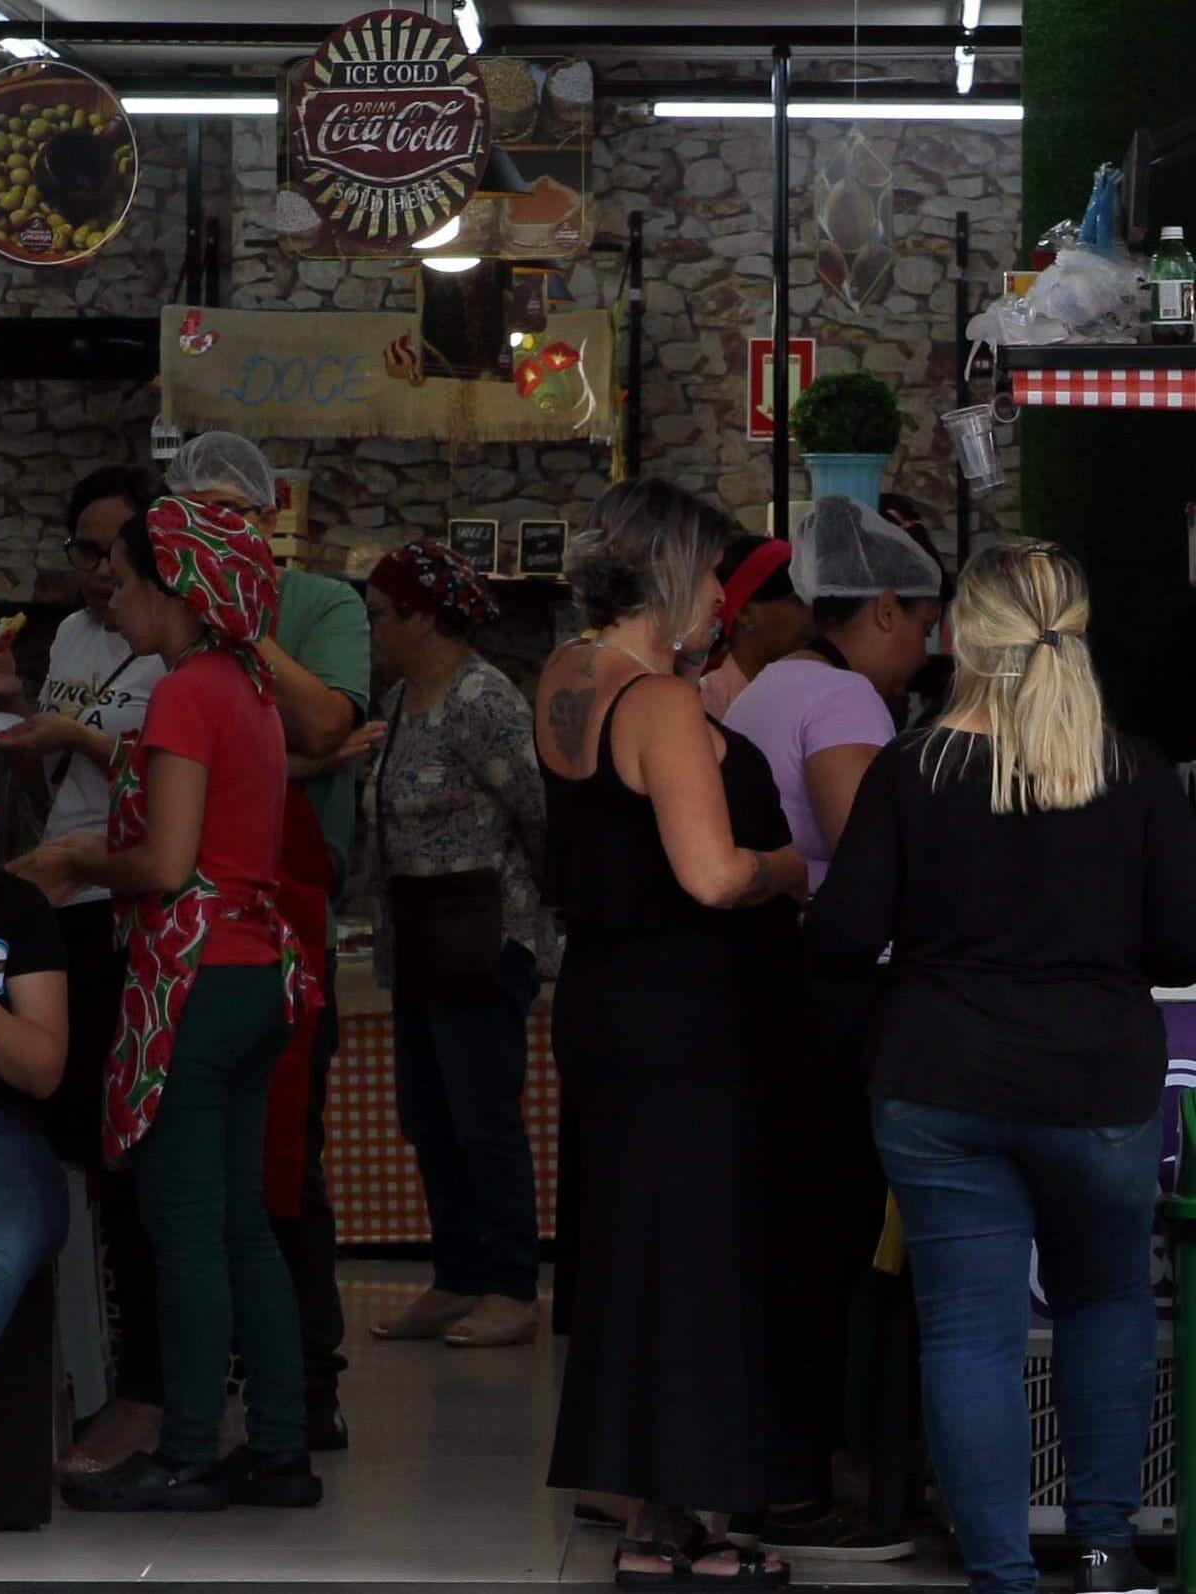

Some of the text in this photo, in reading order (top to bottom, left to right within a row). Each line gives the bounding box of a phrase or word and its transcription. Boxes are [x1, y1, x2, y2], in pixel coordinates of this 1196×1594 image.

[345, 64, 438, 84] ICE COLD
[354, 101, 397, 113] DRINK
[335, 176, 446, 214] SOLD HERE
